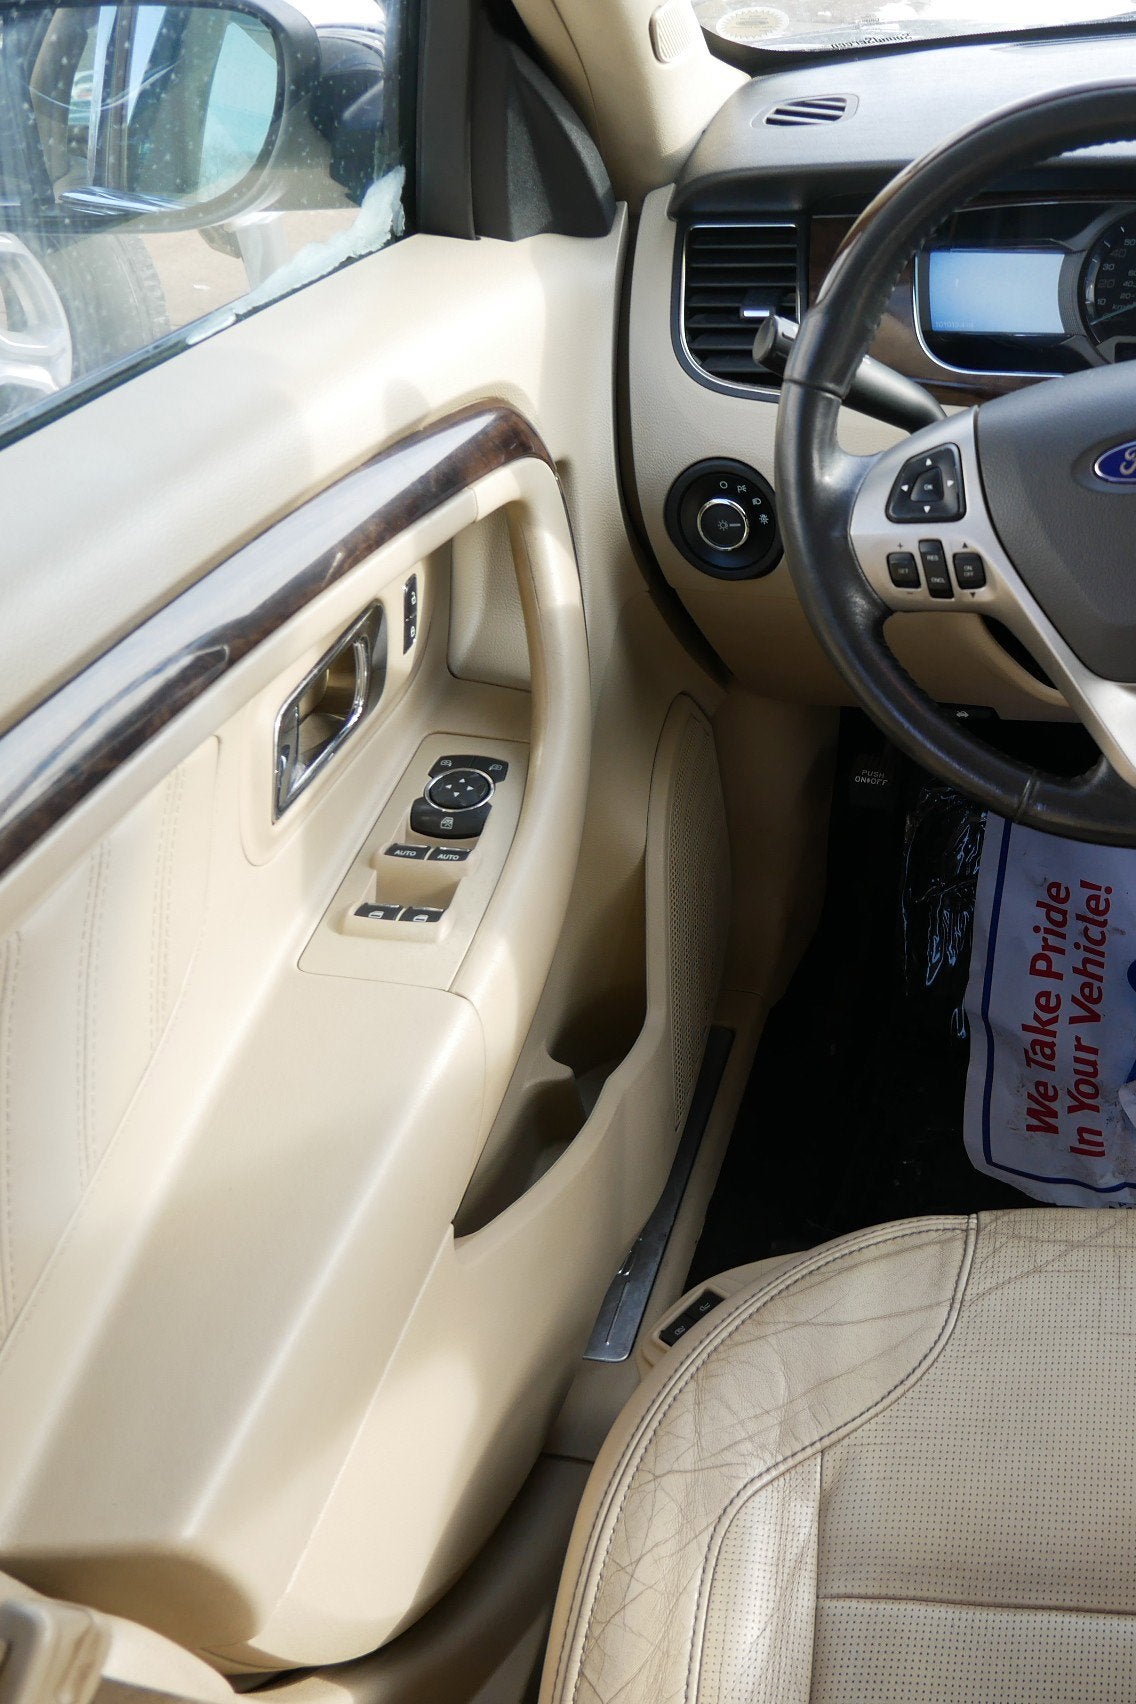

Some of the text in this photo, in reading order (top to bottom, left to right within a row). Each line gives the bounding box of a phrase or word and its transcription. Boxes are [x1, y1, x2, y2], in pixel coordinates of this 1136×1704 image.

[1110, 248, 1127, 258] 40
[861, 769, 885, 778] PUSH
[437, 853, 460, 861] AUTO
[1022, 881, 1071, 1134] We Take Pride
[1067, 879, 1113, 1157] In Your Vehicle!
